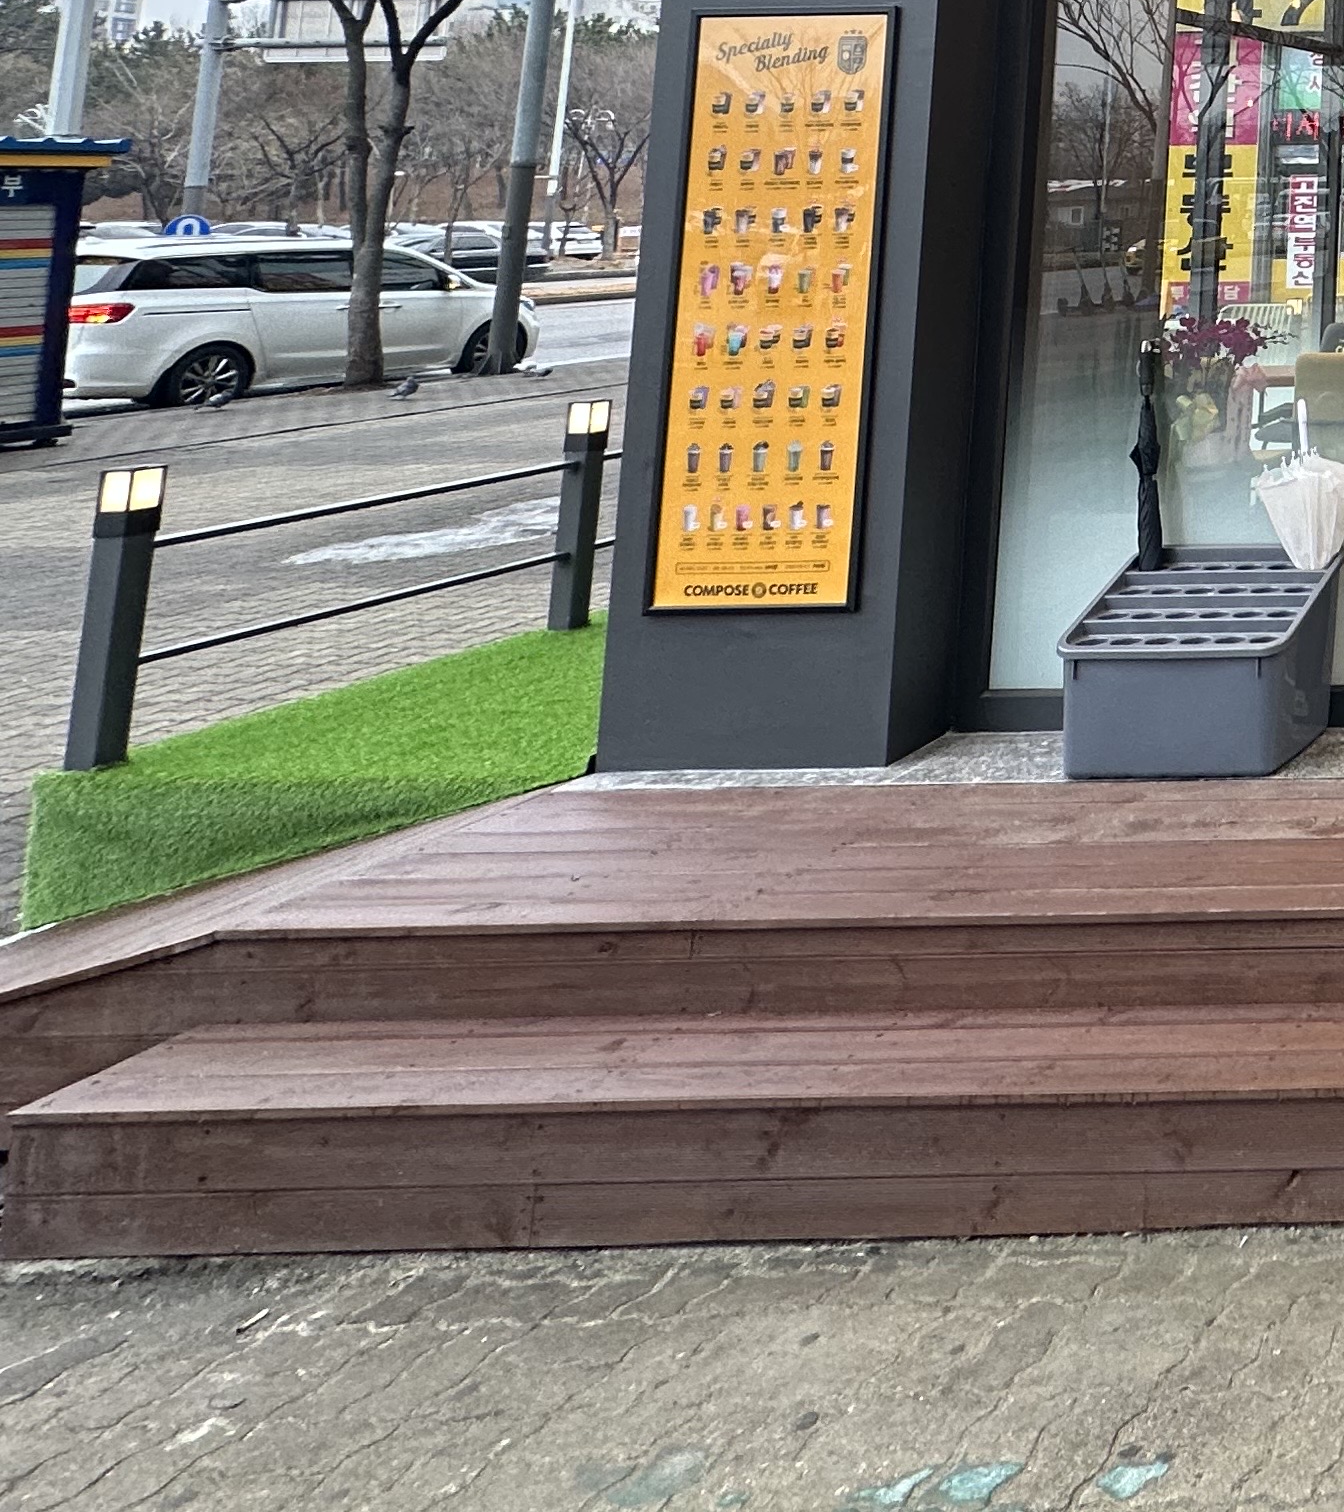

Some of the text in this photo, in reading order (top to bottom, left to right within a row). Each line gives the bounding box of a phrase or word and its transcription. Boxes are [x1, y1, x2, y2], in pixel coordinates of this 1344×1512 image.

[715, 31, 793, 62] Specialty
[754, 45, 830, 73] Blending
[684, 582, 818, 597] COMPOSE COFFEE
